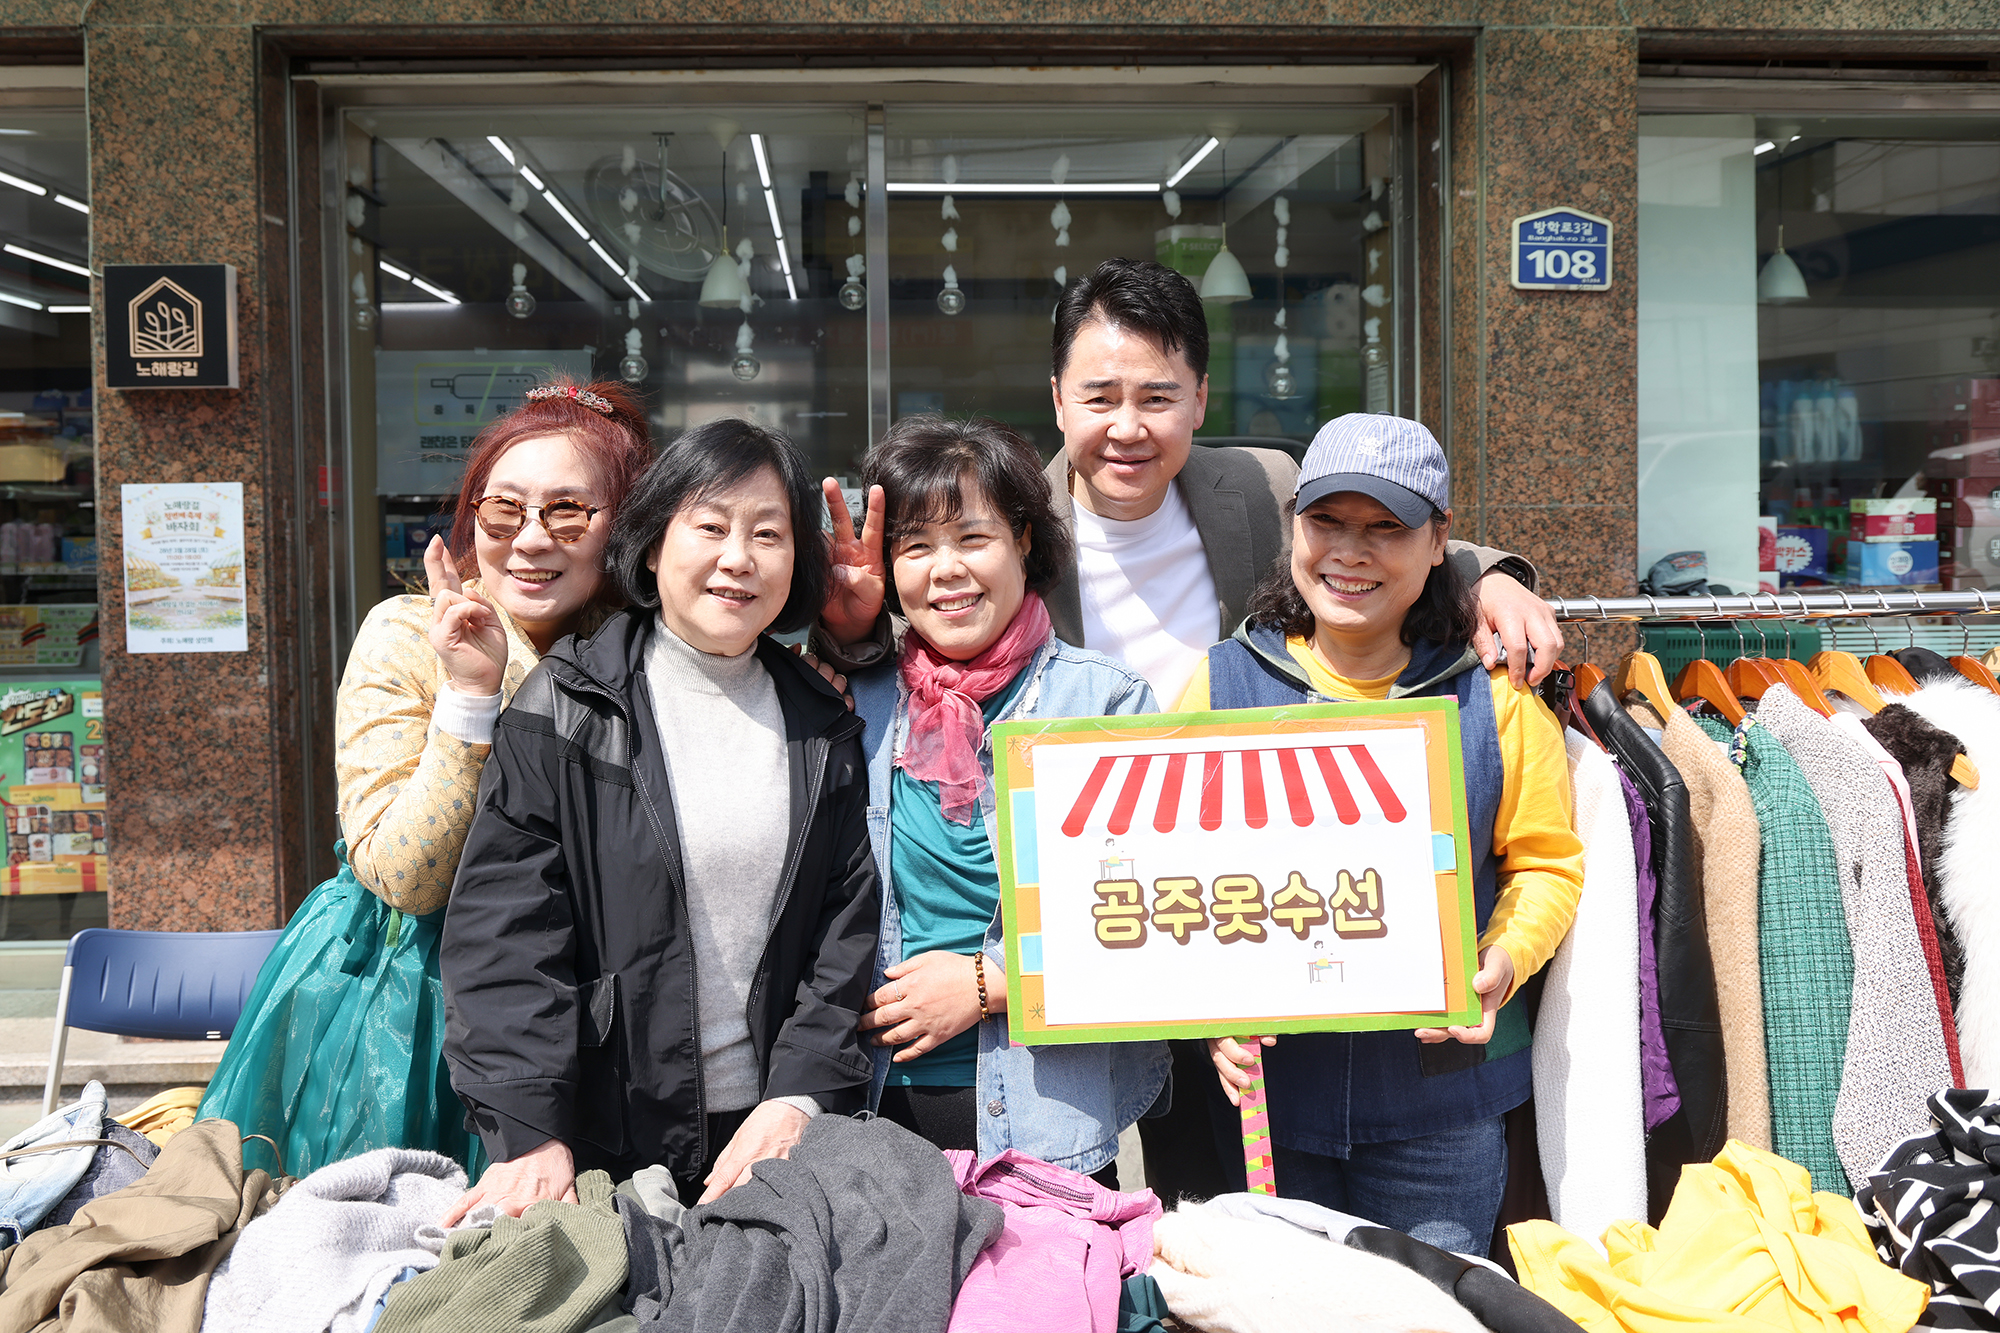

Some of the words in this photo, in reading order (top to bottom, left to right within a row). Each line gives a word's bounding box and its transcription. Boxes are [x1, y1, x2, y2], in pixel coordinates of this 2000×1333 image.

[1533, 220, 1593, 236] 방학로3길
[1527, 234, 1578, 242] Banghak-ro
[1580, 235, 1598, 243] 3-gil
[1526, 249, 1597, 279] 108
[136, 361, 199, 377] 노해랑길
[166, 521, 200, 532] 바자회
[1787, 559, 1794, 568] F
[1092, 867, 1388, 949] 공주옷수선
